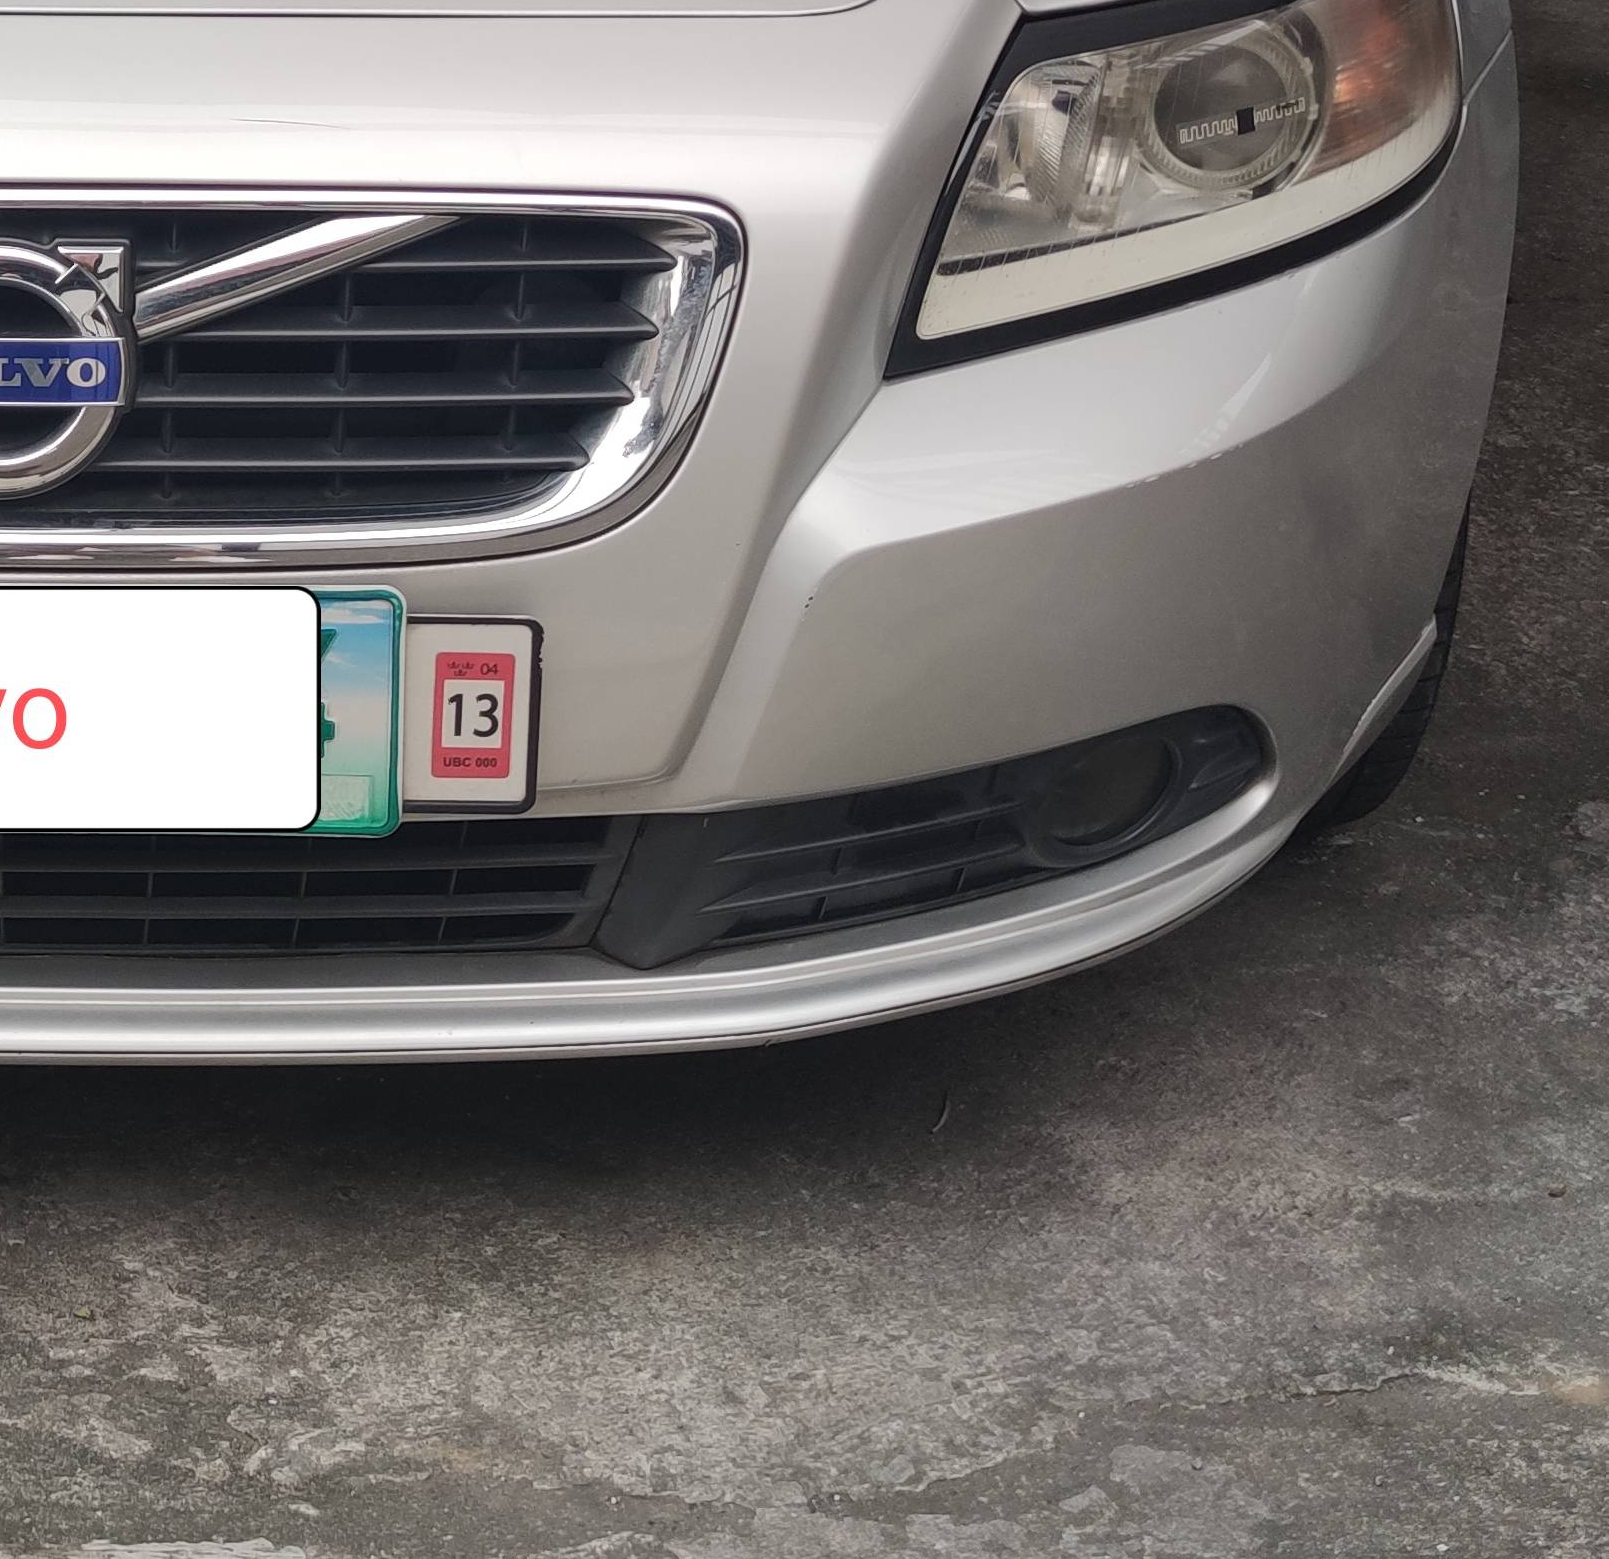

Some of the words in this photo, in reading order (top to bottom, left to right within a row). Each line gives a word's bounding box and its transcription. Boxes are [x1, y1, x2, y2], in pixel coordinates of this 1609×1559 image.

[479, 662, 499, 676] 04
[447, 692, 499, 738] 13
[442, 756, 472, 768] UBC
[475, 757, 498, 769] 000
